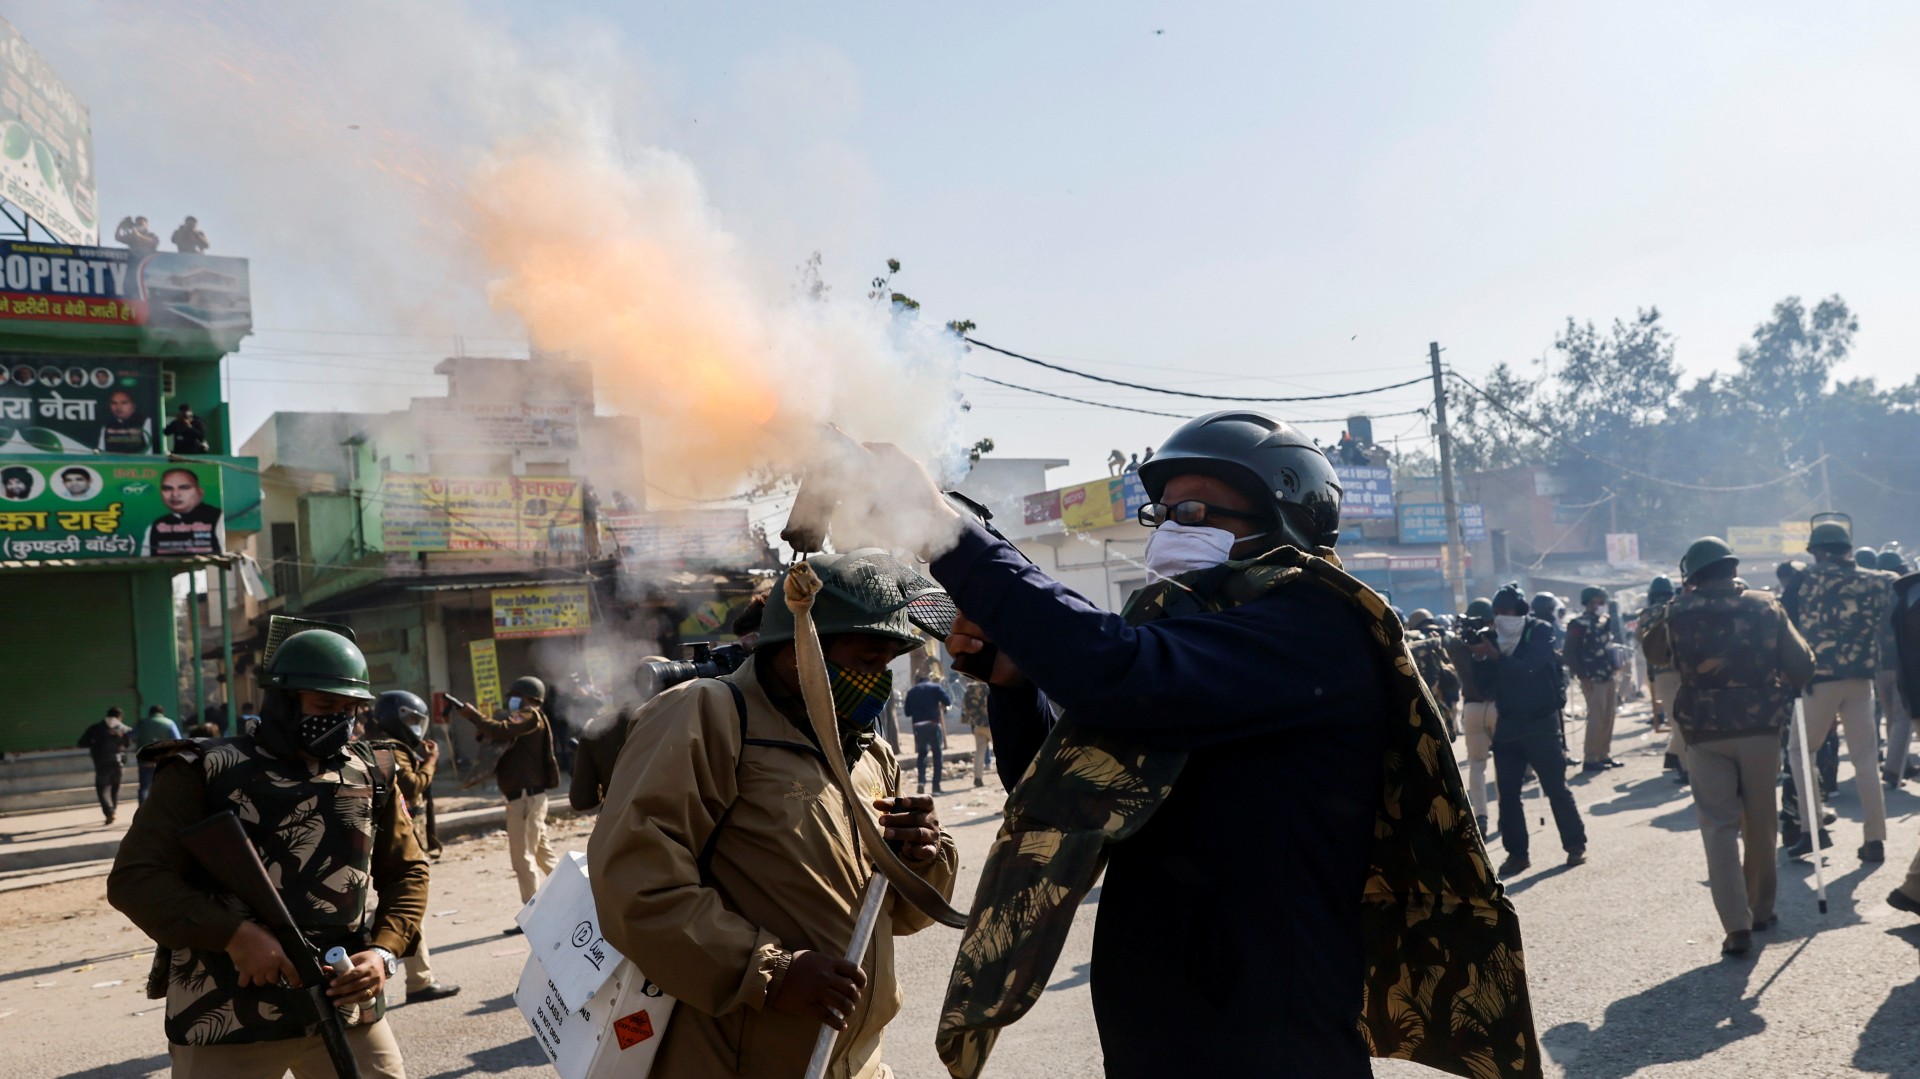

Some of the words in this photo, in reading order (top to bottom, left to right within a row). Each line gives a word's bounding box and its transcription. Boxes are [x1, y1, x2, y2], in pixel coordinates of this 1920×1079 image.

[0, 254, 127, 295] OPERTY
[38, 390, 97, 421] नेता
[56, 503, 123, 533] राई
[4, 535, 80, 560] (कुण्डली
[575, 927, 587, 942] 12
[537, 1006, 544, 1019] DO
[549, 1026, 561, 1045] DROP
[618, 1022, 651, 1038] EXPLOSIVES
